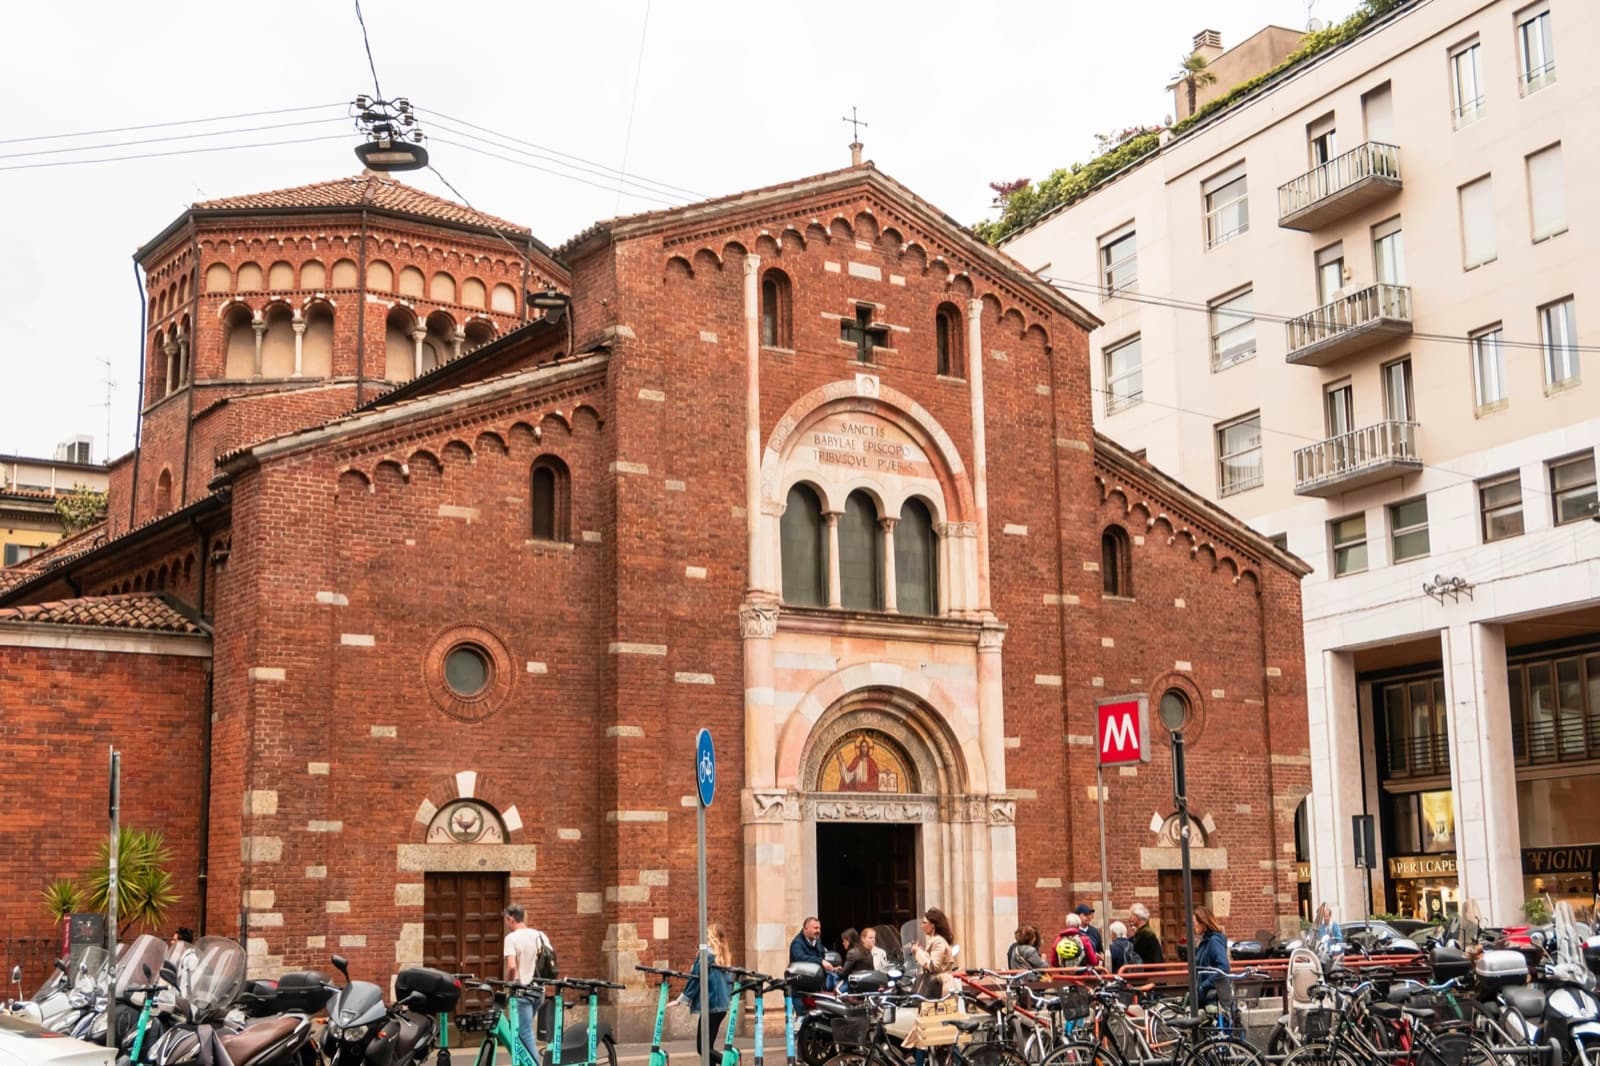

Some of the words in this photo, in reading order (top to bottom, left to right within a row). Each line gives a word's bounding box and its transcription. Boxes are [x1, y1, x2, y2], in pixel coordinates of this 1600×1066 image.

[841, 423, 885, 438] SANCTIS
[864, 440, 911, 457] EPISCOPO
[1102, 713, 1139, 753] M
[1397, 862, 1416, 874] PER
[1426, 860, 1458, 873] CAPE
[654, 1019, 665, 1043] TIER
[727, 1019, 736, 1042] TIER
